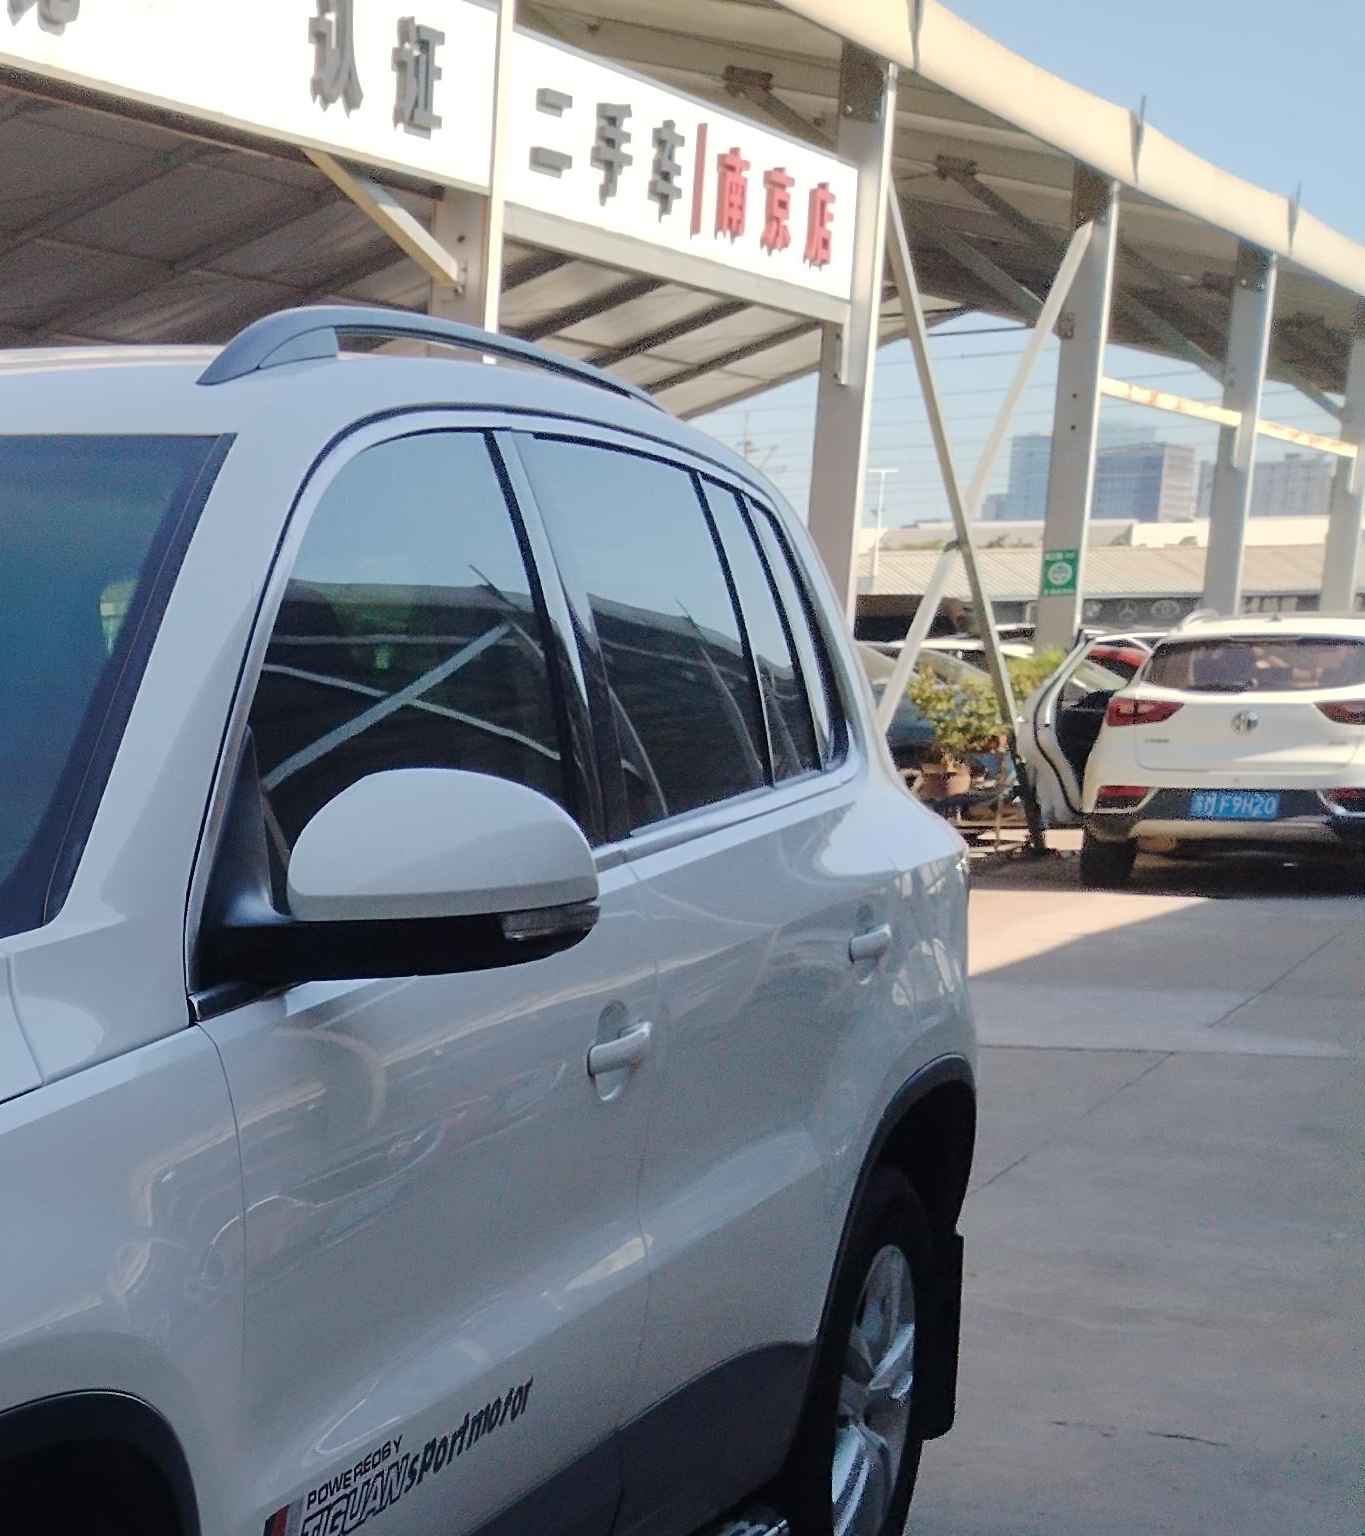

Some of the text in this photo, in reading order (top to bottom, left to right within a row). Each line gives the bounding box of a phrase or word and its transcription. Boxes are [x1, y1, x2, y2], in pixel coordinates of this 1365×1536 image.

[308, 0, 445, 140] 认证
[529, 88, 836, 271] 二手车 南京店
